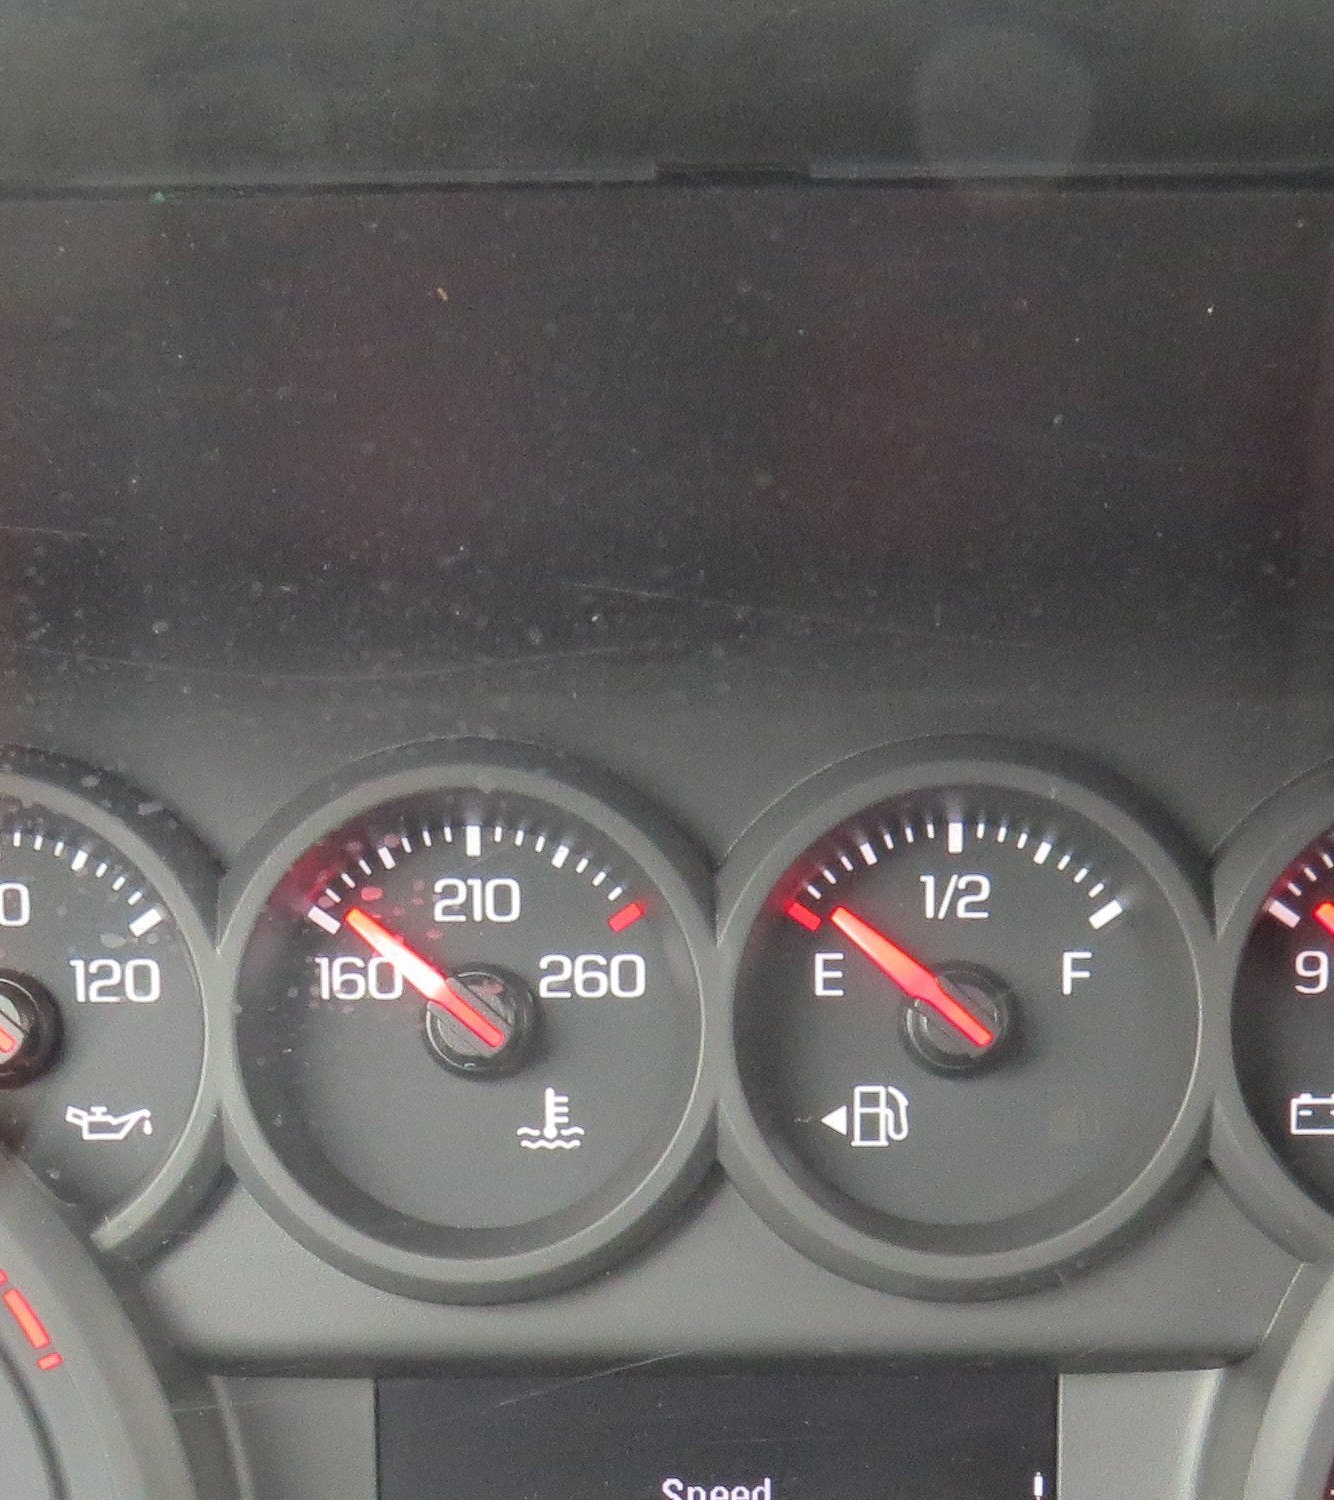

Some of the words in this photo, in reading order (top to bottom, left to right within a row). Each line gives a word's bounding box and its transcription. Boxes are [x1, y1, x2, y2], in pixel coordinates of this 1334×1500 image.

[433, 877, 521, 923] 210
[919, 874, 991, 920] 1/2
[69, 957, 161, 1003] 120
[314, 956, 404, 1000] 160
[538, 953, 646, 999] 260
[814, 952, 844, 997] E
[1062, 951, 1093, 995] F
[1295, 950, 1329, 994] 9
